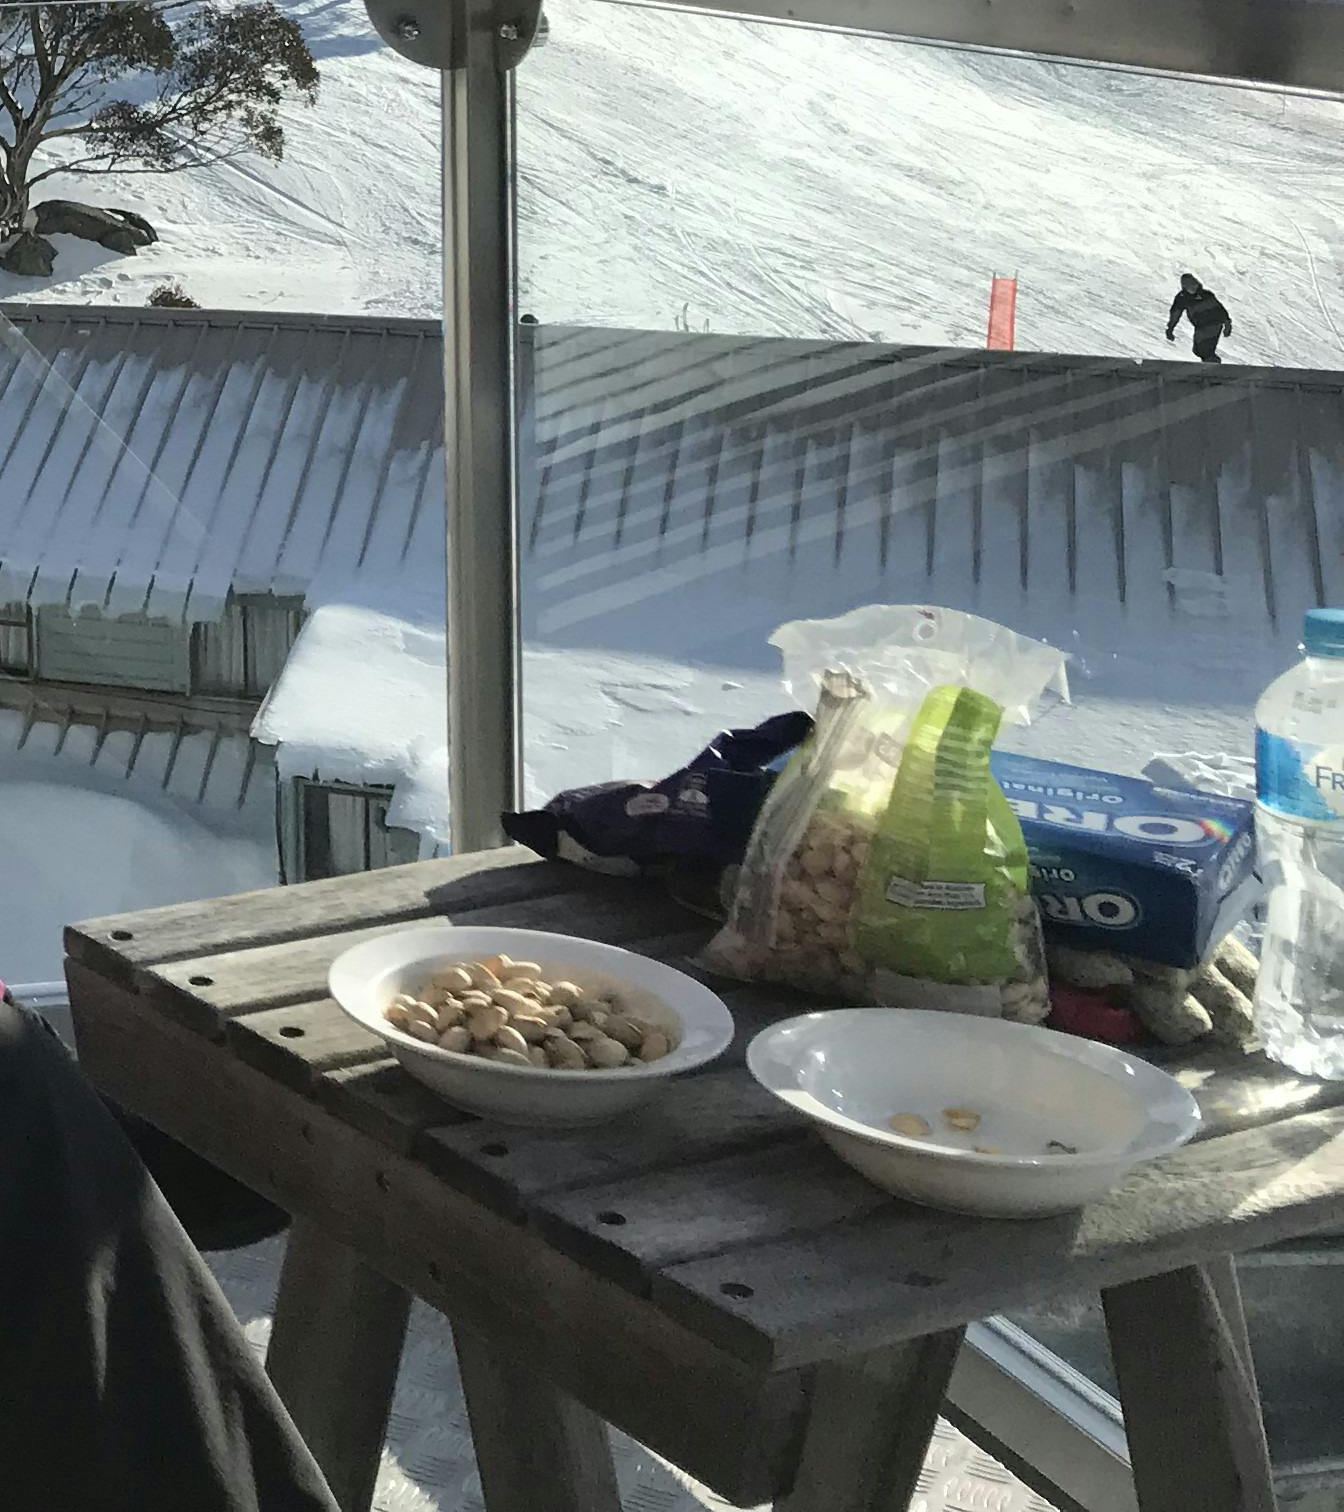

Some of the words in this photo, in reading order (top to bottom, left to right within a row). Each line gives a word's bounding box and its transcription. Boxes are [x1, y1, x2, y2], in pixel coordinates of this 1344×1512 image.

[1000, 780, 1124, 805] Original
[1006, 797, 1205, 845] ORE
[1041, 891, 1137, 926] OR
